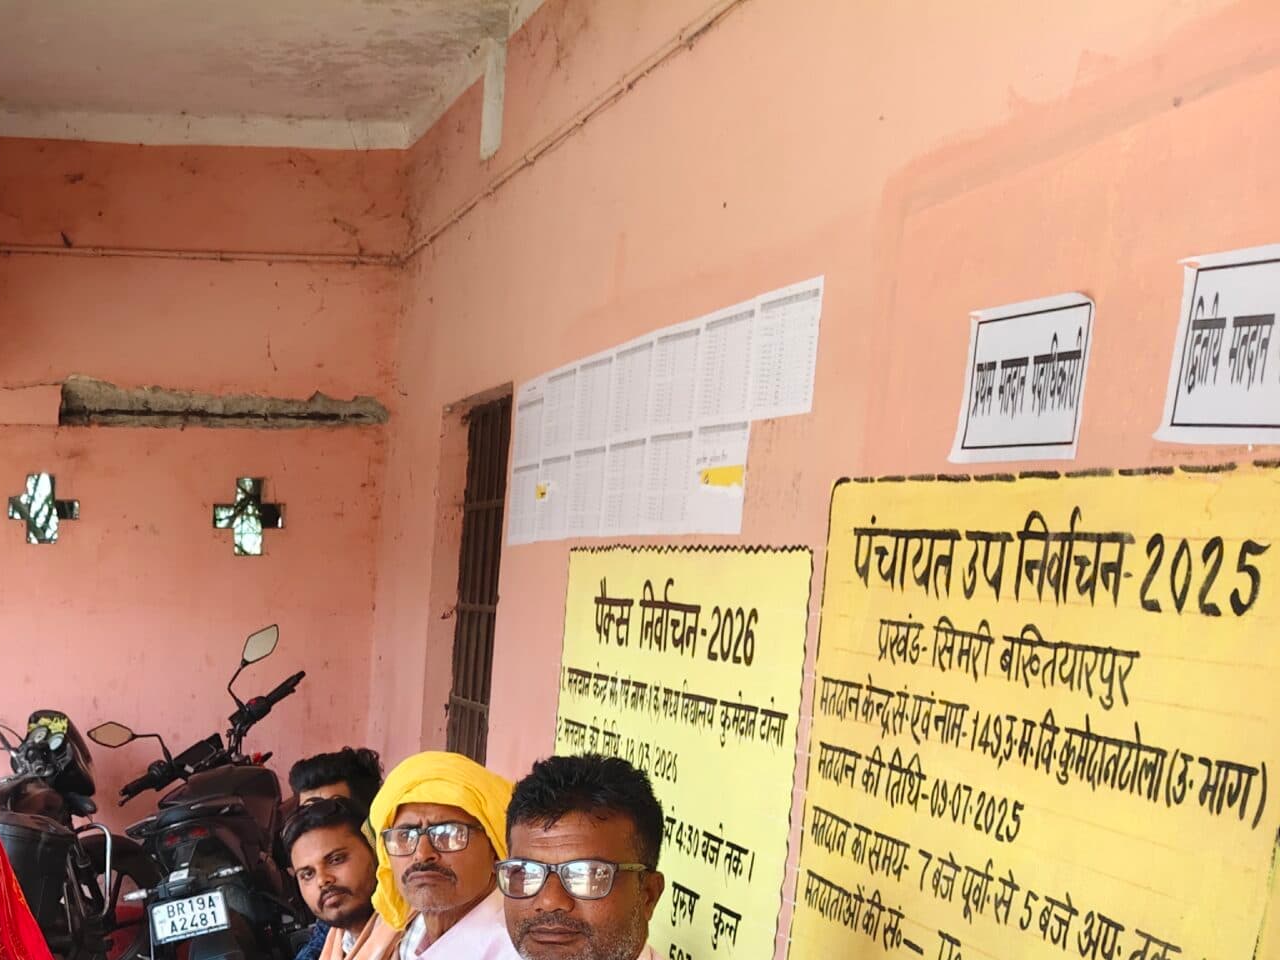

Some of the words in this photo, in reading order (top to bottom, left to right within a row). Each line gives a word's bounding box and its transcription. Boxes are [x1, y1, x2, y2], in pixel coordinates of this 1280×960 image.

[971, 361, 997, 418] प्रथम
[998, 356, 1028, 420] मतदान
[1031, 325, 1082, 416] पदाधिकारी
[1185, 292, 1226, 394] द्वितीय
[1228, 313, 1274, 393] मतदान
[853, 514, 962, 600] पंचायत
[963, 531, 1014, 602] उप
[594, 576, 634, 647] पैक्स
[567, 666, 592, 699] मतदान
[932, 615, 995, 682] सिमरी
[819, 676, 863, 722] मतदान
[861, 673, 895, 740] केन्द्र
[911, 690, 937, 746] एवं
[818, 741, 862, 789] मतदान
[861, 745, 886, 798] की
[701, 822, 724, 872] बजे
[811, 805, 852, 857] मतदान
[851, 822, 872, 865] का
[919, 848, 932, 891] 7
[932, 851, 961, 902] बजे
[995, 869, 1020, 925] से
[1020, 890, 1039, 931] 5
[1039, 891, 1079, 952] बजे
[170, 910, 218, 934] A2481
[805, 869, 864, 932] मतदाताओं
[862, 889, 886, 942] की
